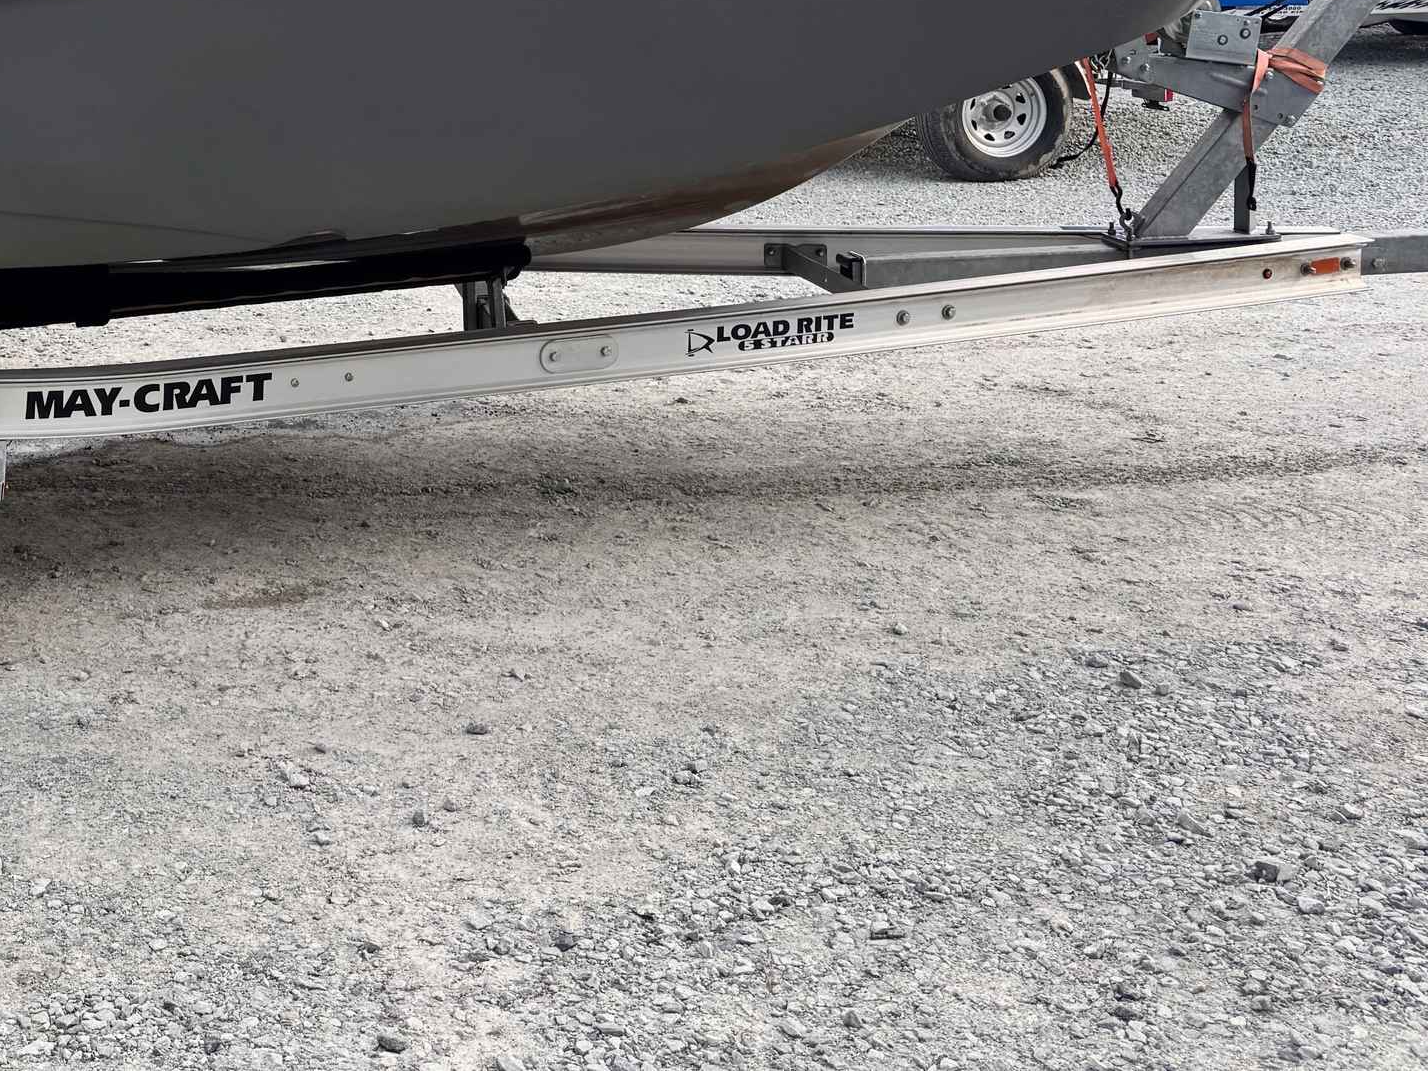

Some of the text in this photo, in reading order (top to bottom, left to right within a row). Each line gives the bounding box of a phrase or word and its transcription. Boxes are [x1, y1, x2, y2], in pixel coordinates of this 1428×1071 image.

[716, 313, 855, 343] LOAD RITE
[25, 372, 272, 420] MAY-CRAFT
